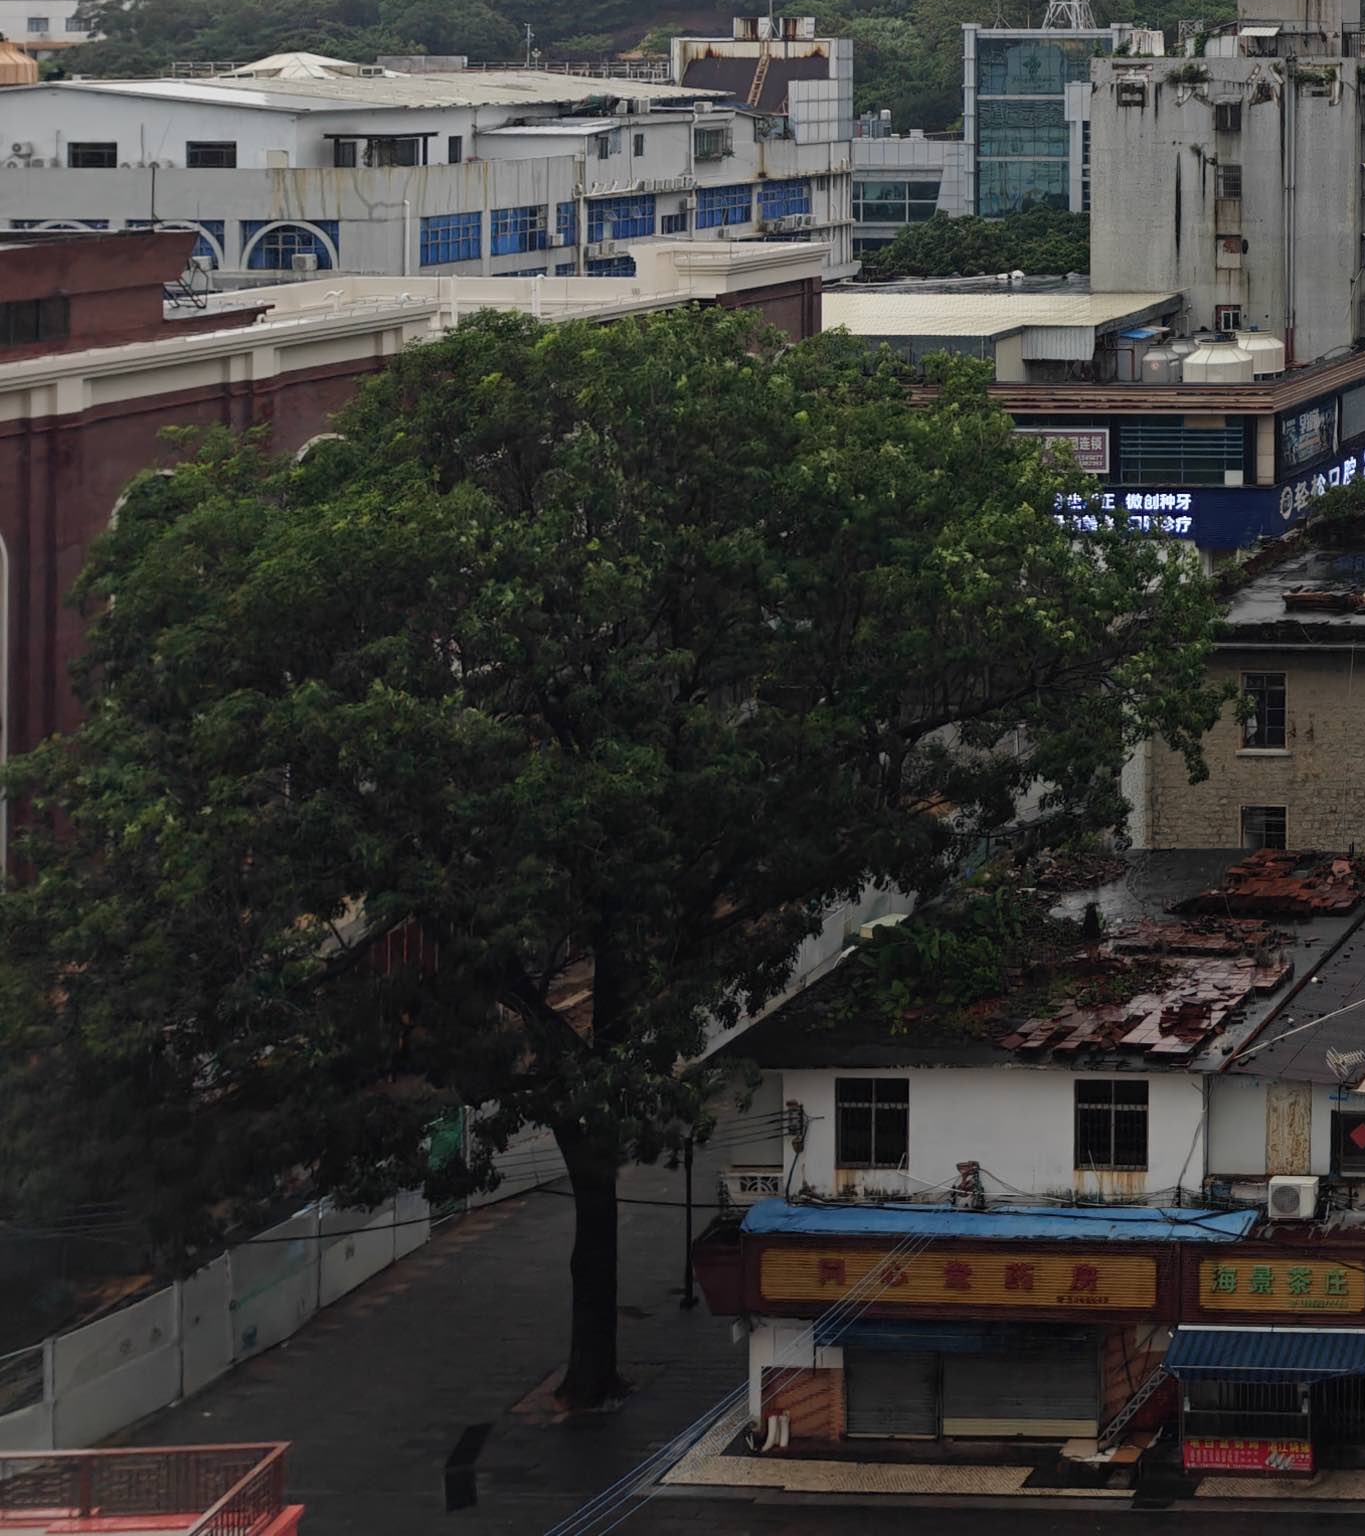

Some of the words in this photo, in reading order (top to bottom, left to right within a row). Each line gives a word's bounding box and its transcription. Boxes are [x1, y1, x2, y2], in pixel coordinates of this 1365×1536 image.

[1125, 493, 1193, 511] 微创种牙
[1211, 1265, 1348, 1296] 海景茶庄
